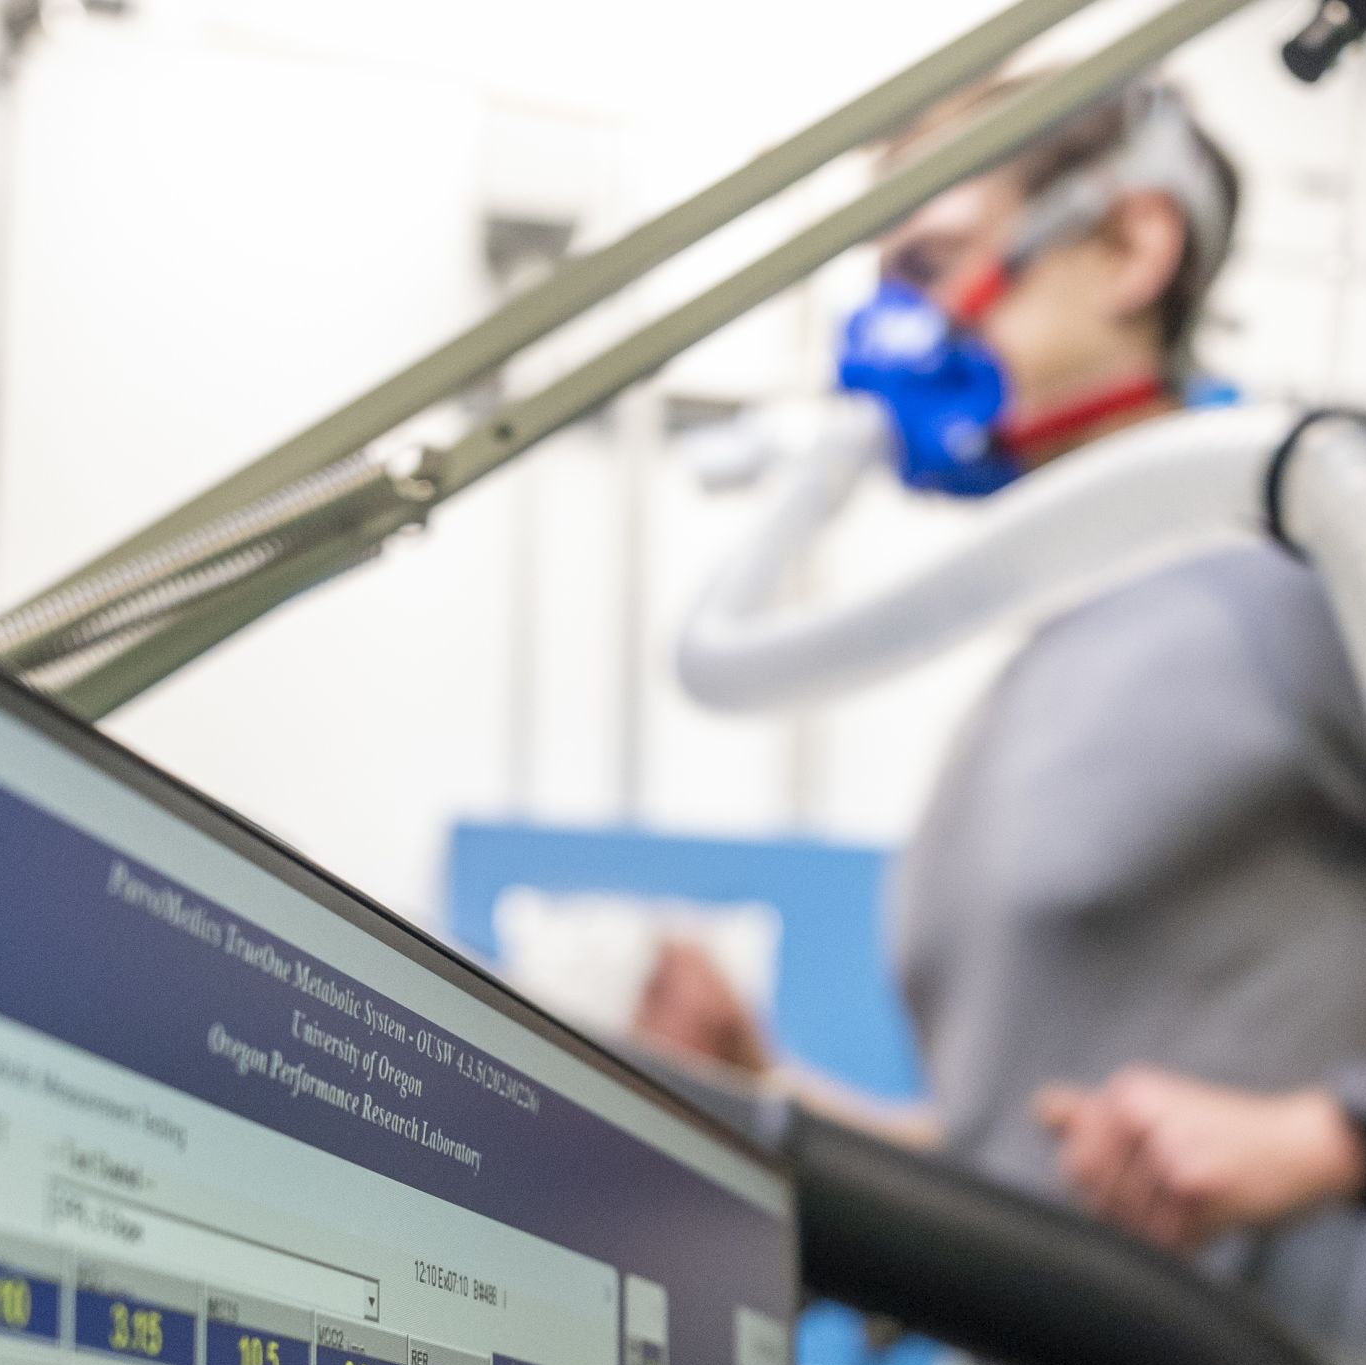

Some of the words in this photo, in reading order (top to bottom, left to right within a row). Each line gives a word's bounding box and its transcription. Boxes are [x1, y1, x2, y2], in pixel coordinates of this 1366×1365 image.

[224, 923, 291, 983] TrueOne
[292, 960, 362, 1020] Metabolic
[363, 999, 406, 1036] System
[206, 1021, 269, 1077] Oregon
[268, 1049, 360, 1116] Performance
[361, 1092, 419, 1143] Research
[420, 1120, 483, 1177] Laboratory
[291, 1009, 360, 1074] University
[361, 1050, 379, 1082] of
[378, 1055, 423, 1099] Oregon
